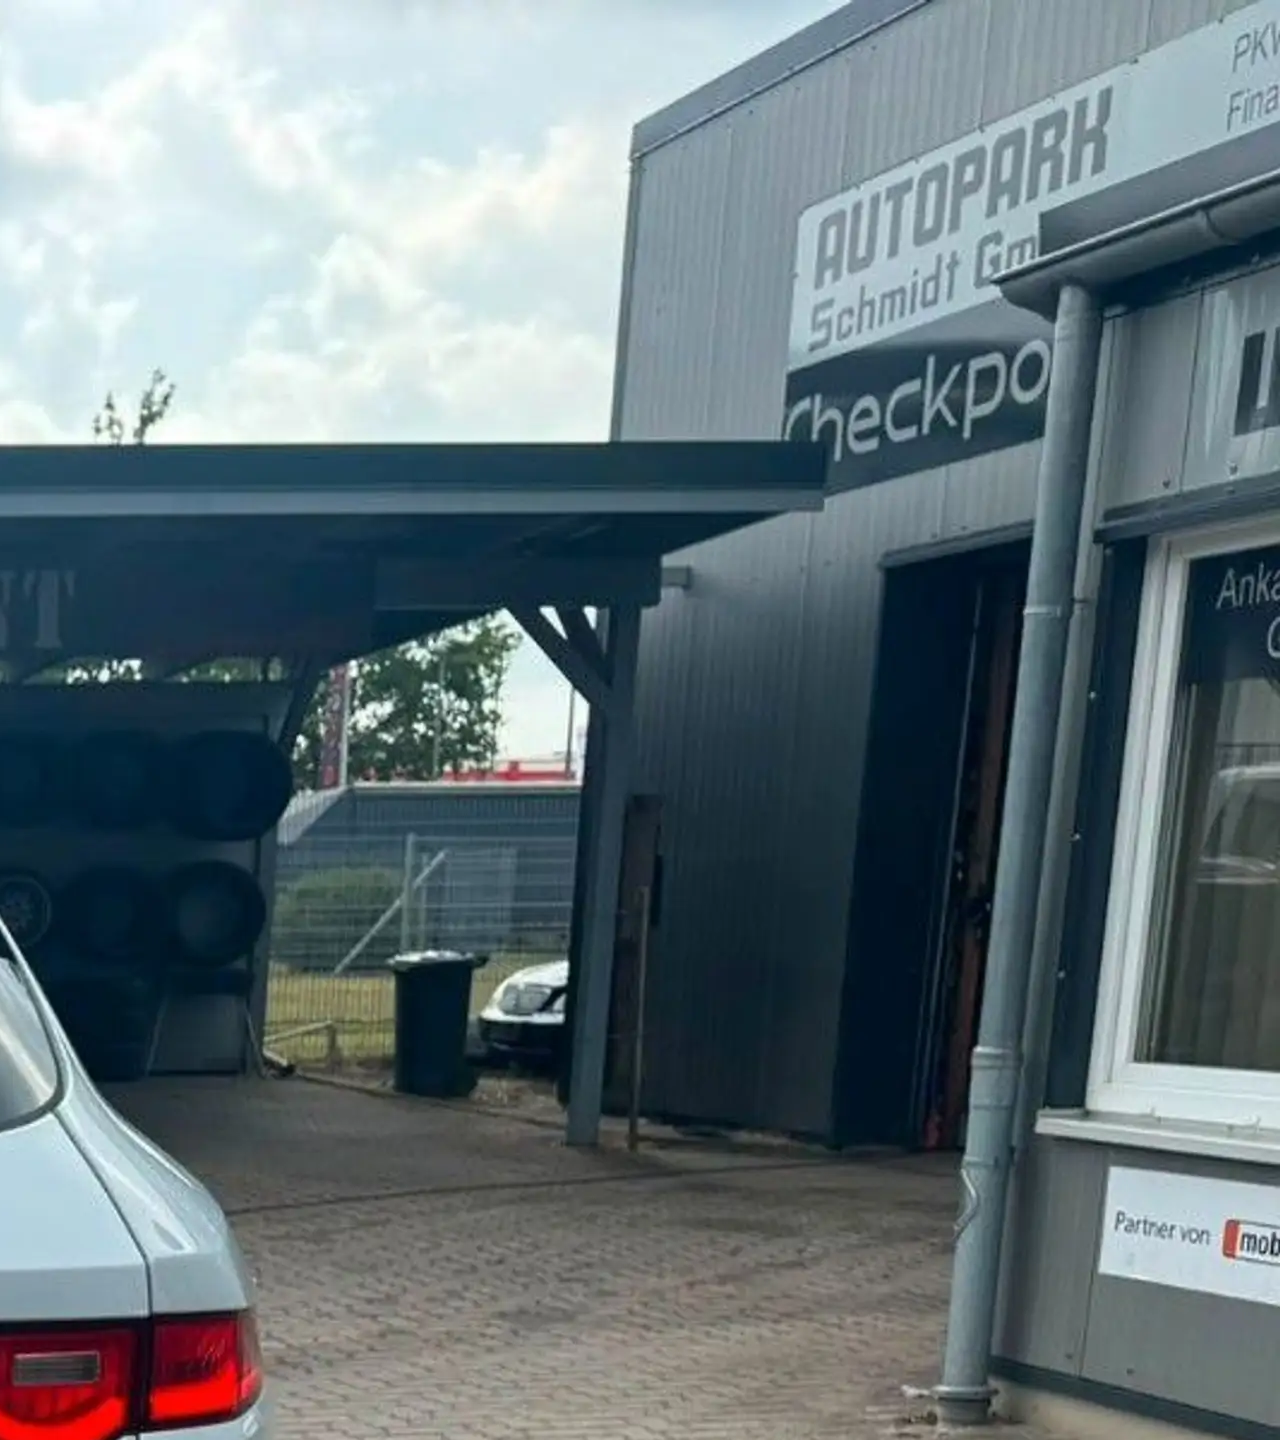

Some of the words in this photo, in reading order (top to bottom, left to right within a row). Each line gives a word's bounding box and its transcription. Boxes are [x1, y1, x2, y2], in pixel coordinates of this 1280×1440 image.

[814, 86, 1113, 290] AUTOPARK
[808, 248, 960, 353] Schmidt
[1114, 1210, 1177, 1240] Partner
[1180, 1225, 1210, 1245] von
